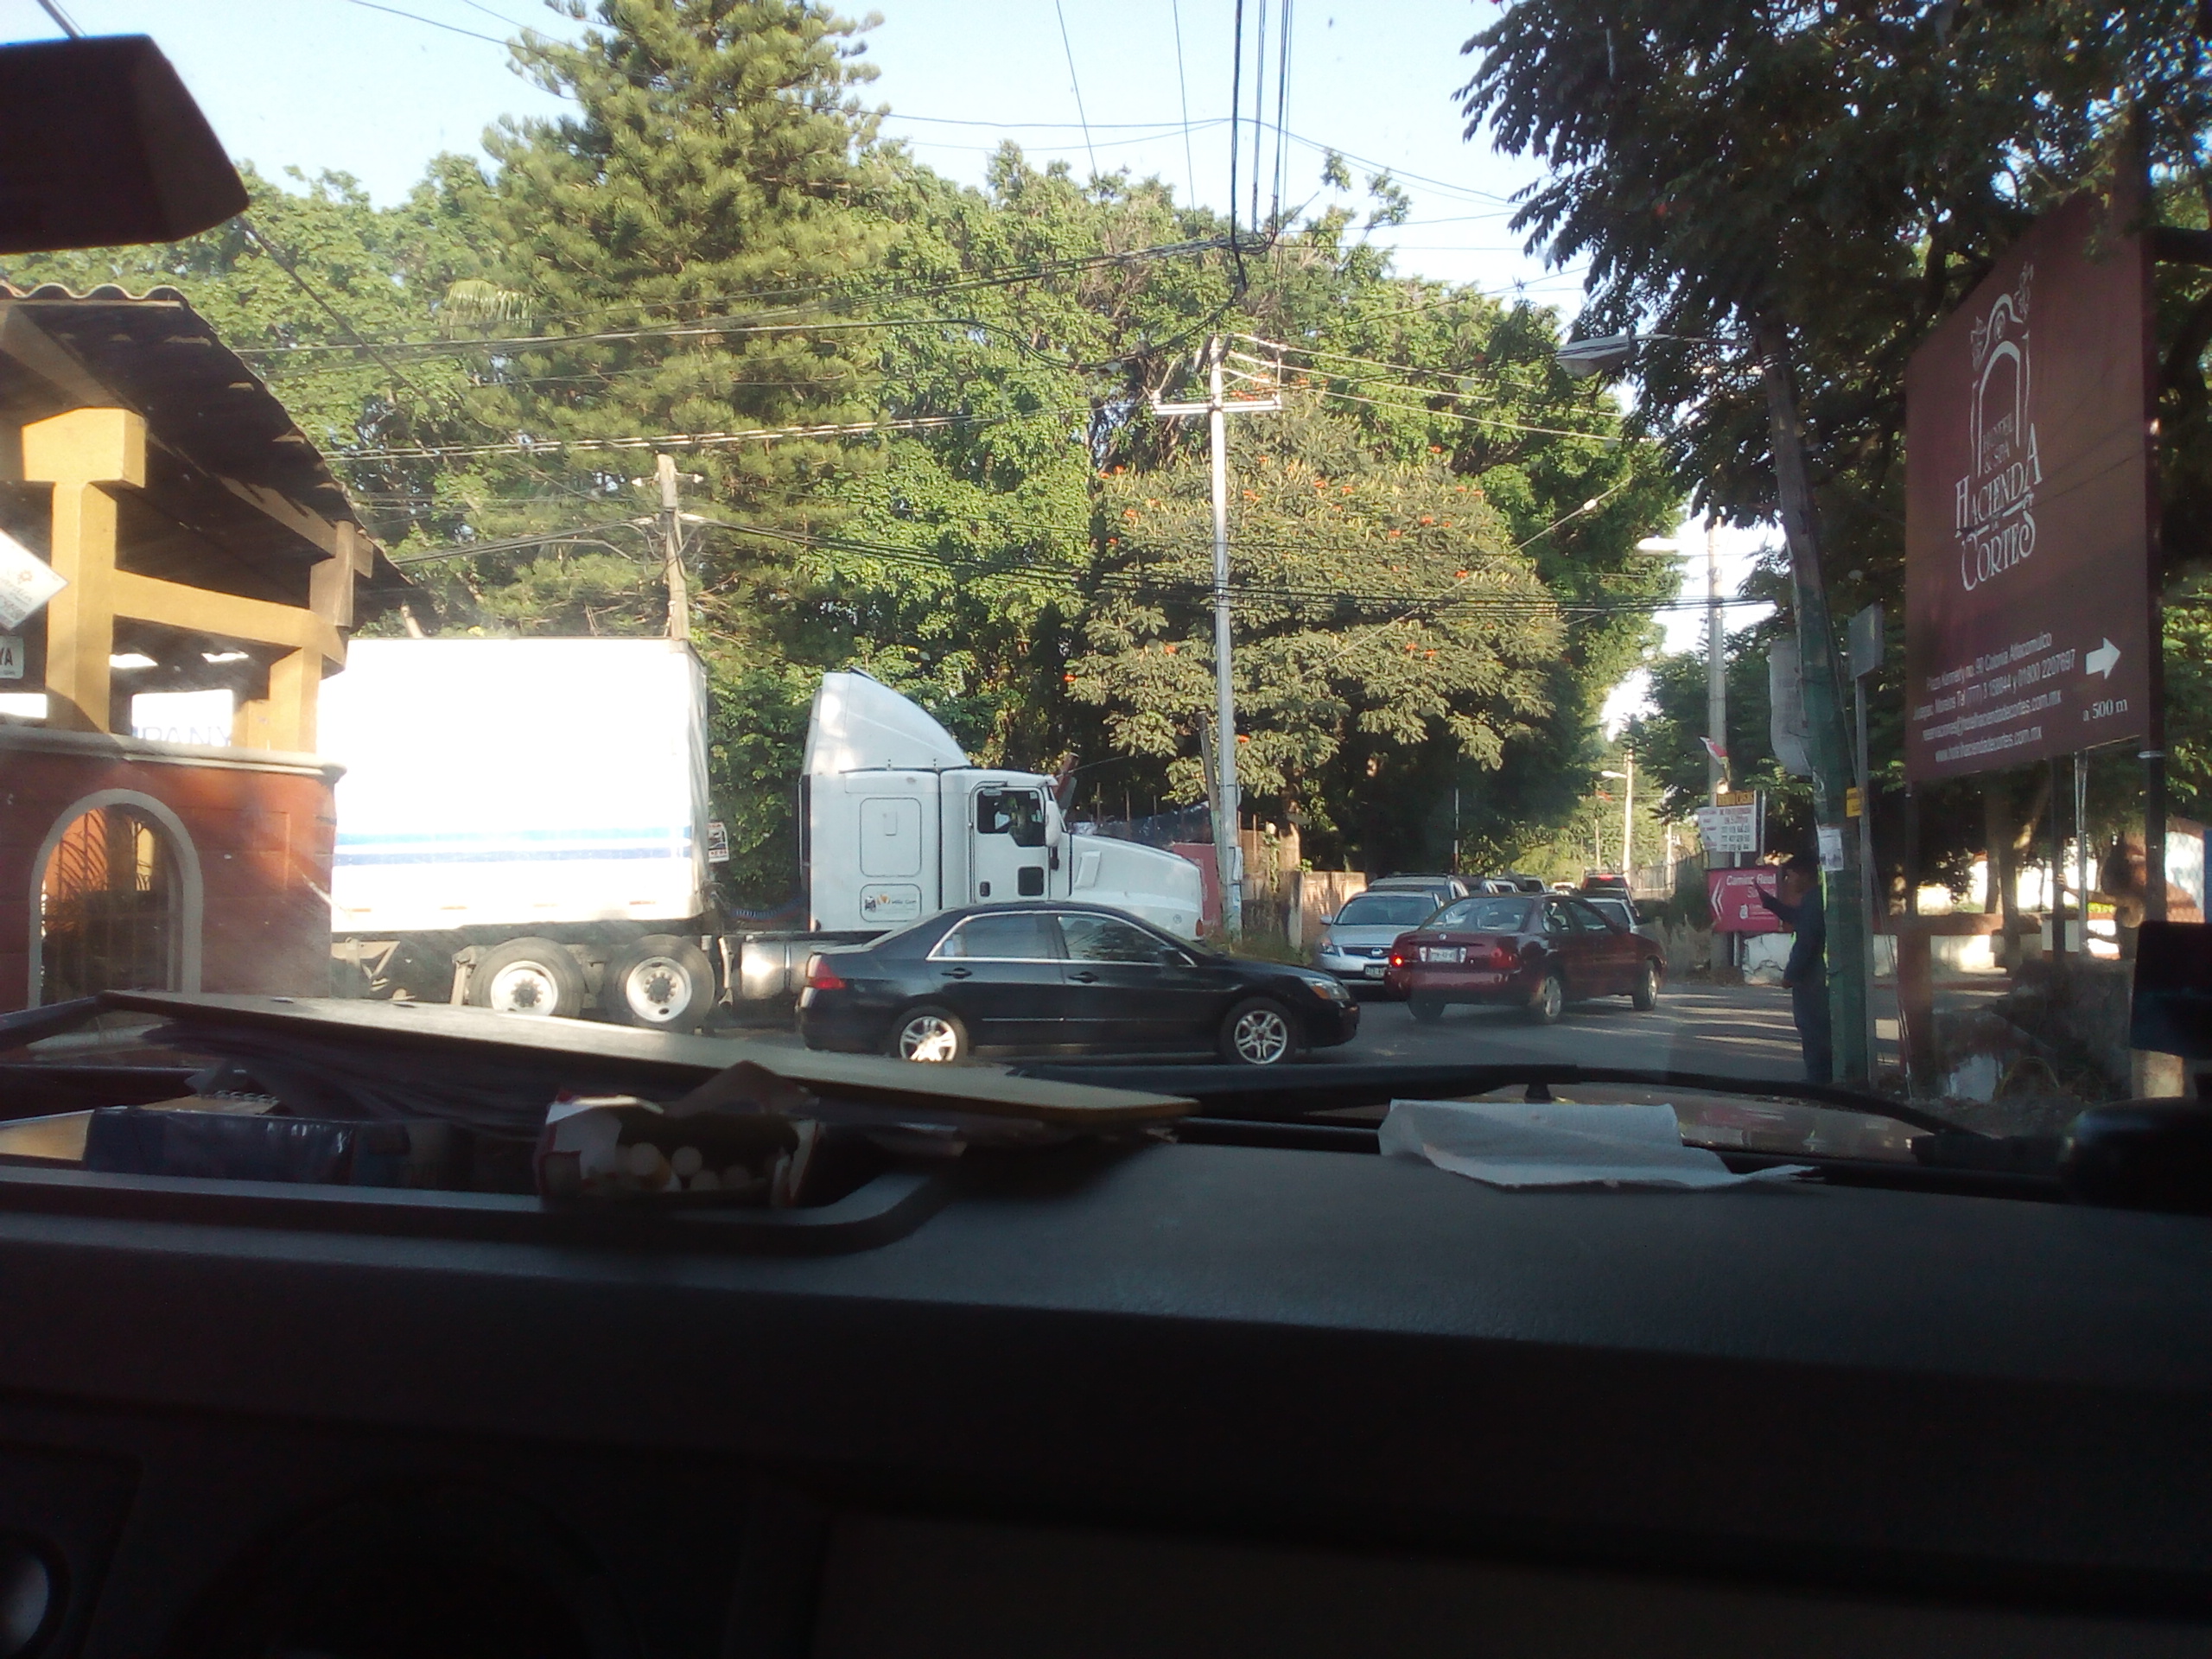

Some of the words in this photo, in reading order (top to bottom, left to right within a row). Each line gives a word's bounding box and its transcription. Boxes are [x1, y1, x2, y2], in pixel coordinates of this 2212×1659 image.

[1954, 423, 2043, 538] HACIENDA
[1961, 492, 2037, 591] CORTES
[2092, 698, 2113, 720] 500
[2115, 699, 2128, 714] m
[1757, 873, 1777, 885] Real
